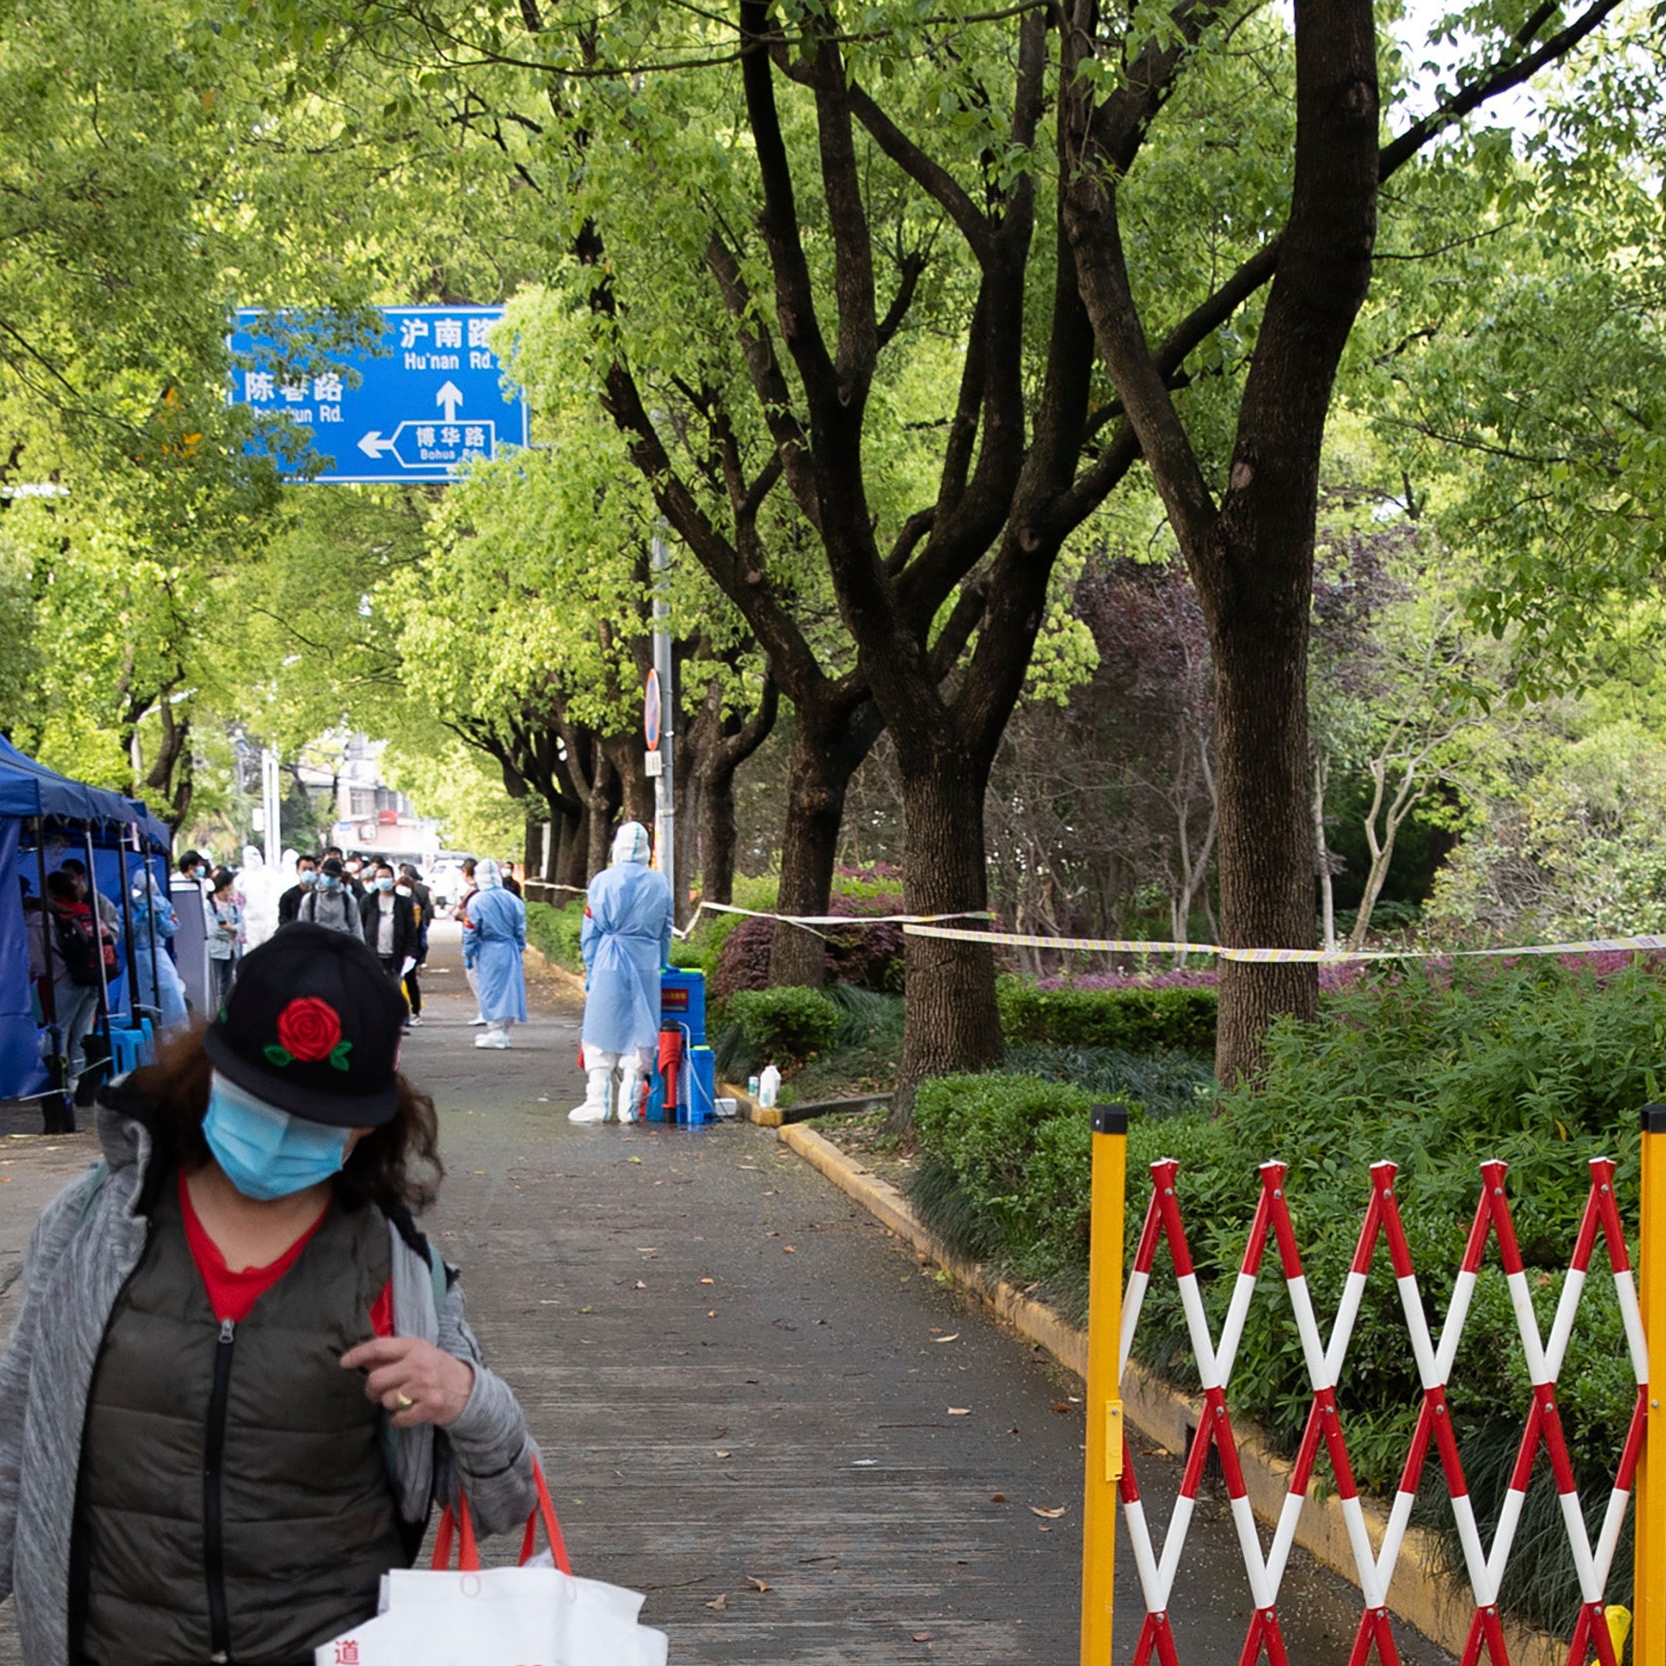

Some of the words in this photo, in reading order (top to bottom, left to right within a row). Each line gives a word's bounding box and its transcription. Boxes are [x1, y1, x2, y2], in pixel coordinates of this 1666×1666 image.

[400, 318, 491, 348] 沪南路
[470, 351, 494, 369] Rd.
[319, 404, 344, 422] Rd.
[416, 426, 485, 447] 博华路
[420, 448, 455, 460] Bohua
